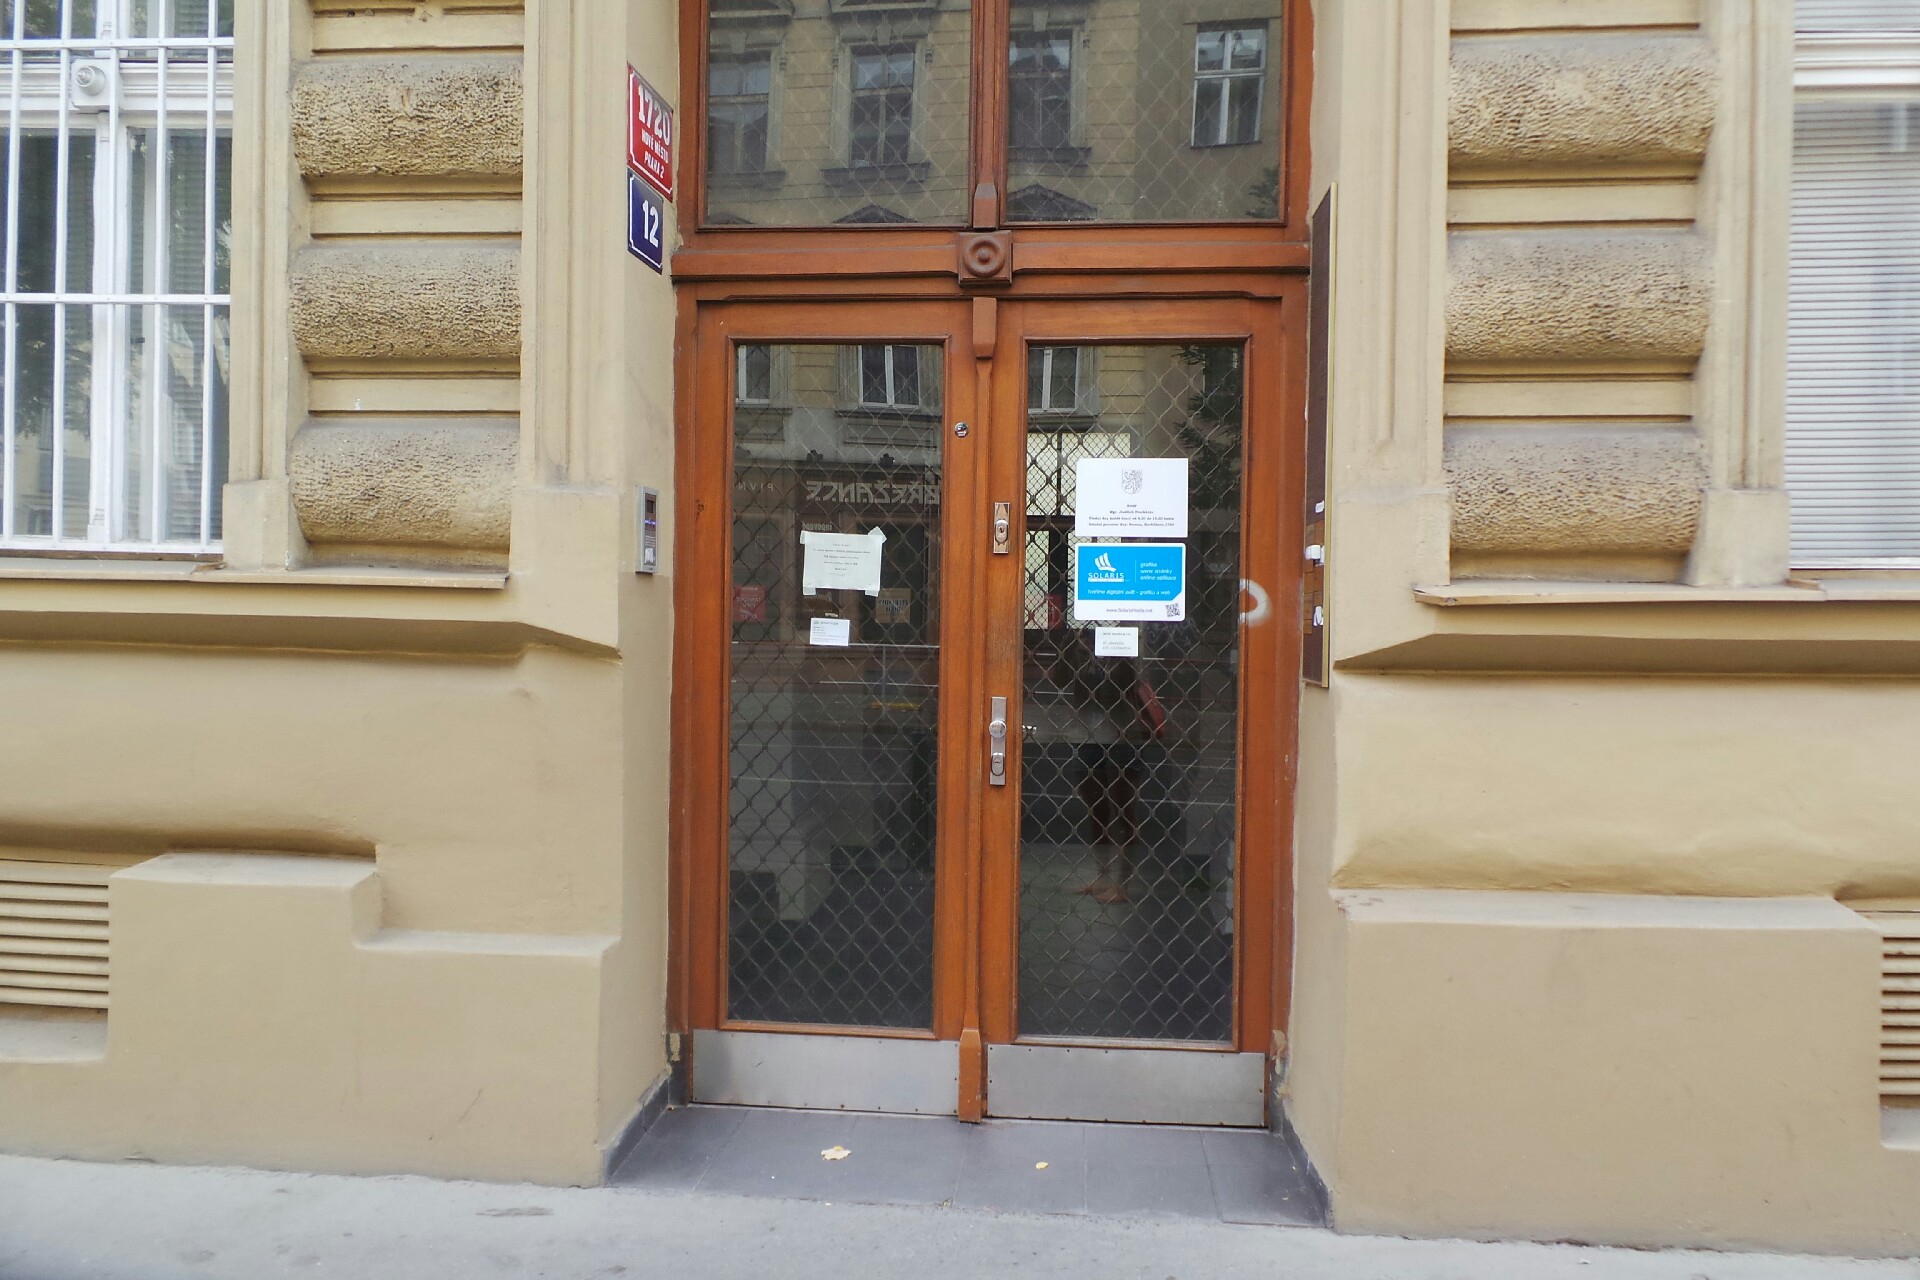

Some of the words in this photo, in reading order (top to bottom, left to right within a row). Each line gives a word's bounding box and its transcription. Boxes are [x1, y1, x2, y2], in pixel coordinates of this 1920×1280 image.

[638, 84, 671, 146] 1720
[641, 128, 654, 150] NOVÉ
[654, 140, 669, 163] MĚSTO
[644, 151, 660, 176] PRAHA
[660, 166, 665, 179] 2
[642, 199, 659, 248] 12
